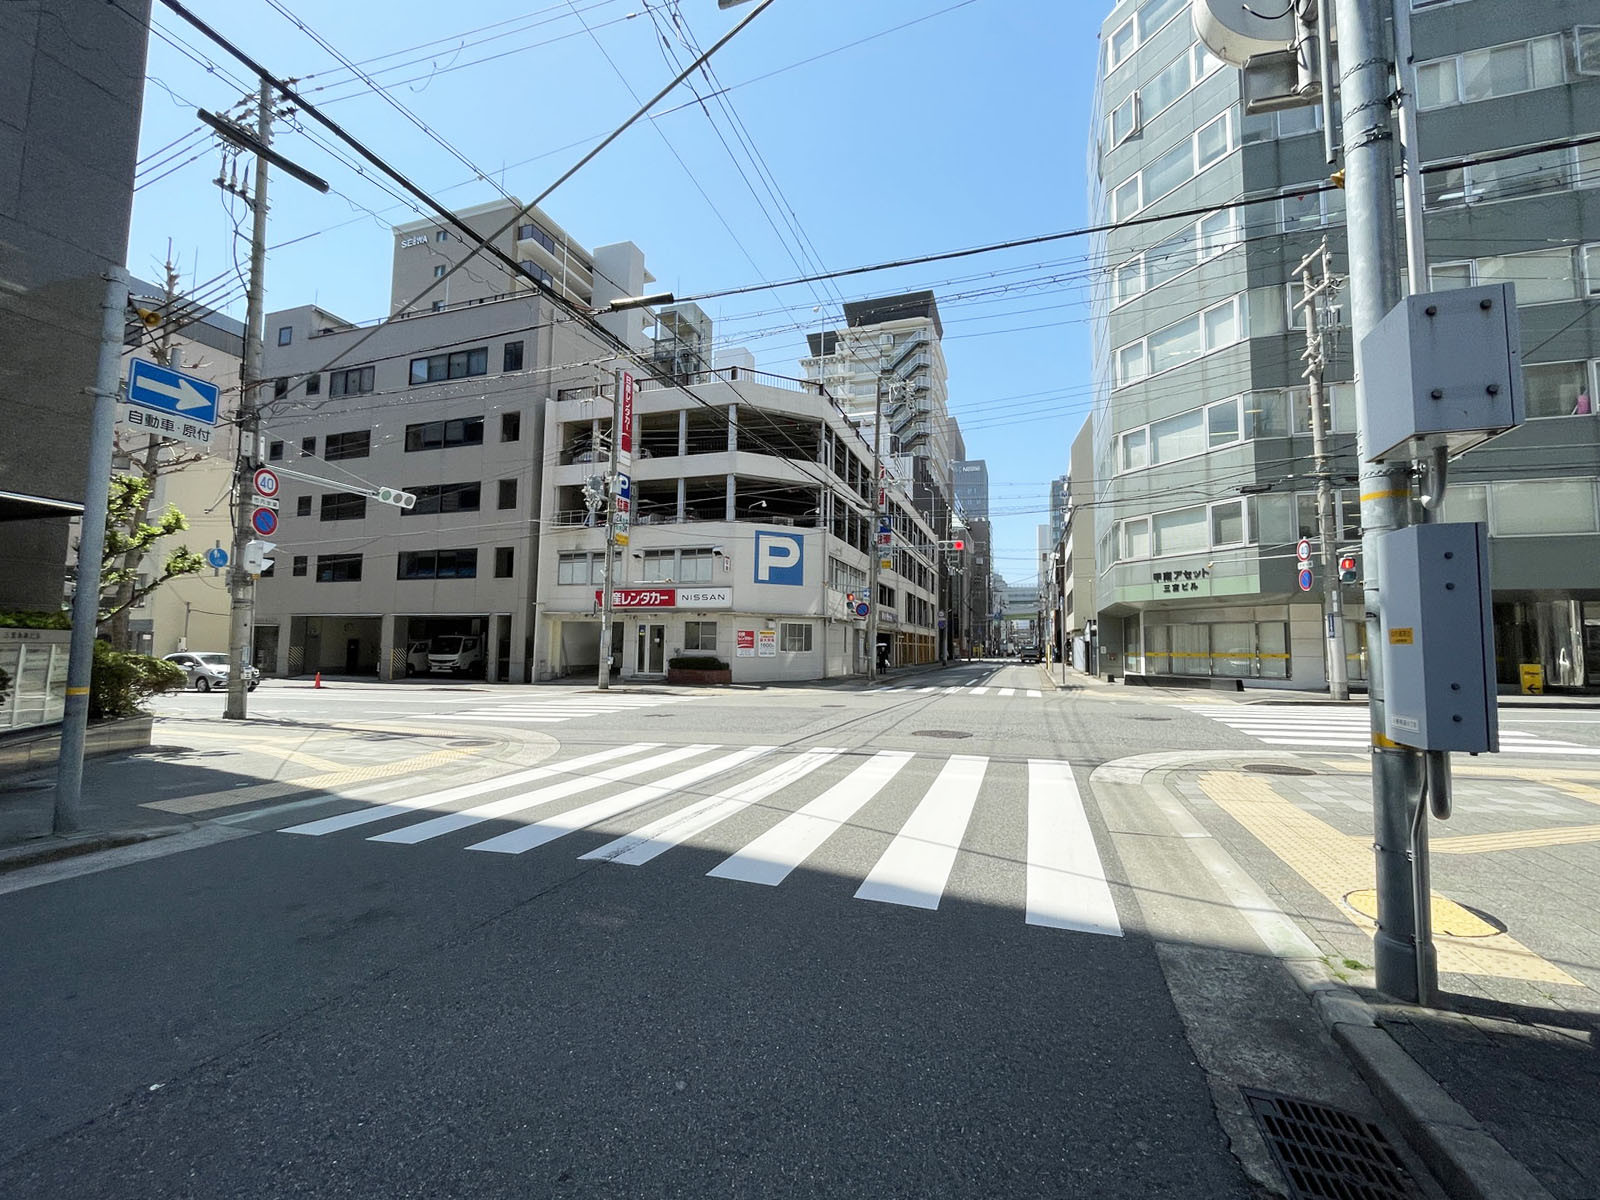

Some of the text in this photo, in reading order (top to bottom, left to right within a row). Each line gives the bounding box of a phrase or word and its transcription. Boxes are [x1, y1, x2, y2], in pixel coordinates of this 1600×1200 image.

[260, 477, 274, 490] 40
[758, 534, 801, 581] P
[612, 591, 669, 606] 産レンタカー
